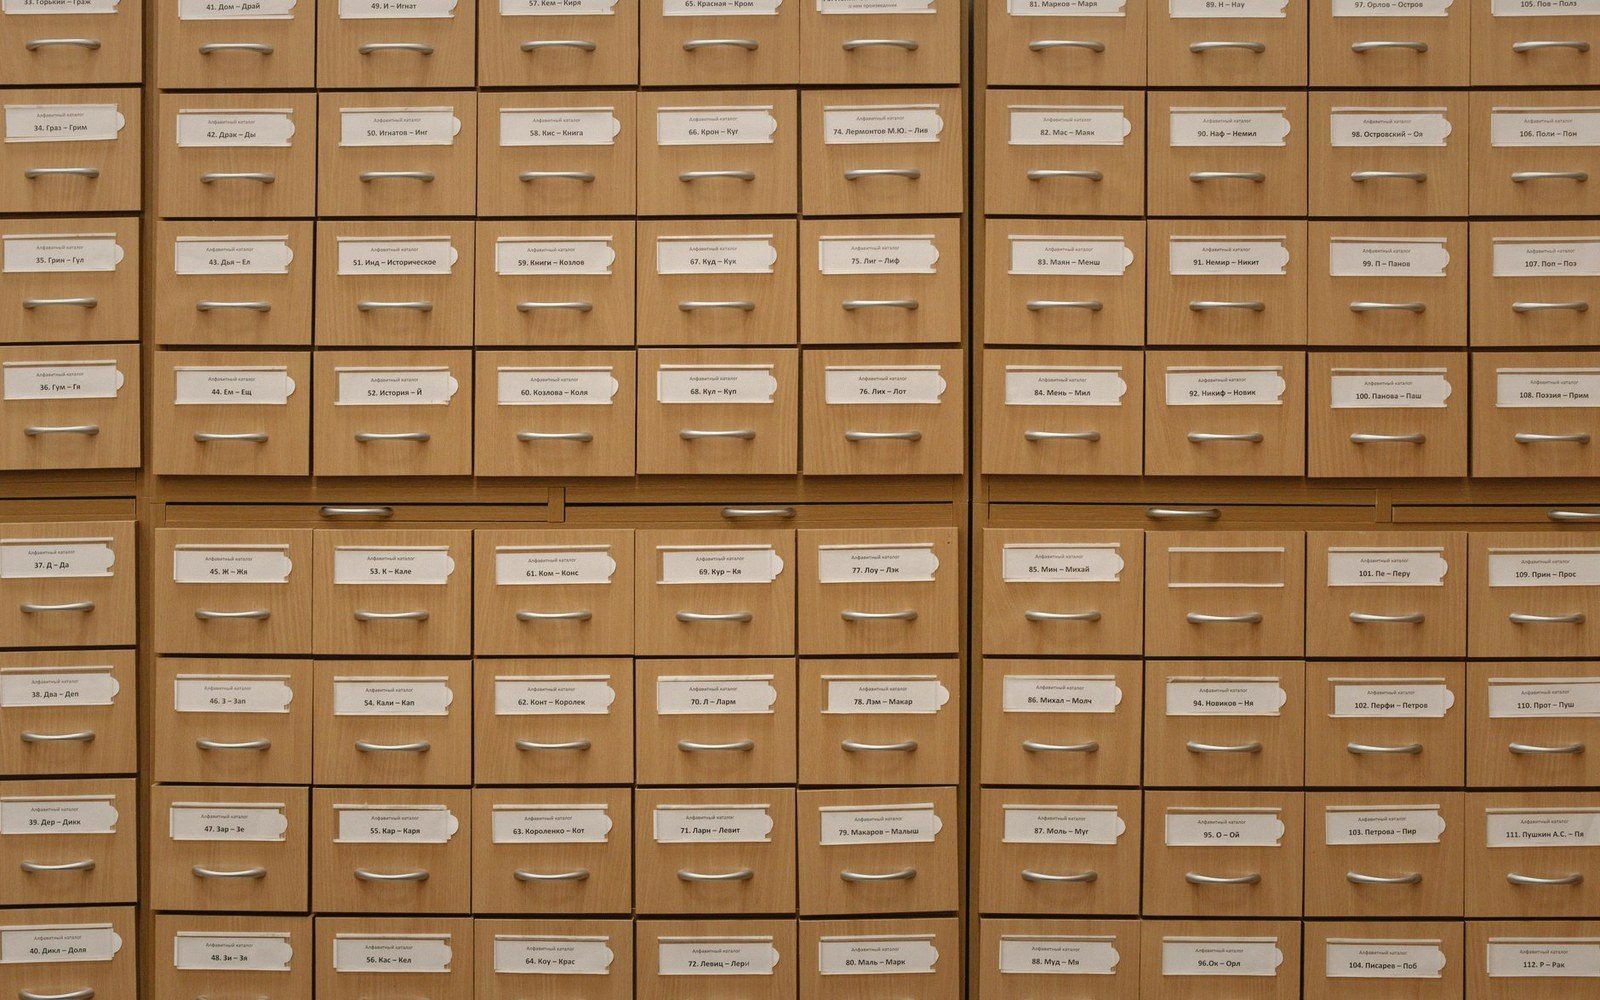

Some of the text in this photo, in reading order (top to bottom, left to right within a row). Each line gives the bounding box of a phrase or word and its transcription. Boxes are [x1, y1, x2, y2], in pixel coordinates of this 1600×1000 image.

[370, 2, 382, 10] 49.
[697, 0, 727, 8] Красная
[734, 0, 754, 8] Кром
[1029, 0, 1098, 8] 81. Марков Маря
[1366, 1, 1391, 10] Орлов
[1397, 1, 1424, 10] Остров
[218, 131, 238, 139] Драк
[243, 131, 256, 139] Ды
[530, 129, 541, 137] 58.
[845, 128, 886, 136] Лермонтов
[1209, 130, 1226, 138] Наф
[1519, 130, 1535, 138] 106.
[1536, 130, 1555, 138] Поли
[47, 256, 65, 265] Грин
[72, 256, 85, 265] Гул
[365, 259, 380, 267] Инд
[387, 259, 437, 267] Историческое
[689, 258, 737, 266] 67. Куд Кух
[1037, 258, 1049, 266] 83.
[223, 388, 234, 396] Ем
[241, 388, 252, 396] Ещ
[1201, 389, 1226, 398] Никиф
[1519, 391, 1589, 400] 108. Поэзия Прим
[59, 561, 70, 569] Да
[369, 567, 381, 575] 53.
[711, 568, 725, 576] Кур
[1392, 570, 1411, 578] Перу
[209, 697, 220, 705] 46.
[233, 697, 246, 705] Зап
[517, 698, 529, 706] 62.
[554, 699, 586, 707] Королек
[854, 698, 913, 706] 78. Лэм Макар
[1533, 701, 1552, 710] Прот
[1558, 701, 1575, 709] Пуш
[29, 818, 81, 827] 39. Дер Дикк
[370, 827, 421, 835] 55. Кар Каря
[692, 827, 711, 835] Ларн
[1034, 827, 1089, 836] 87. Моль Муг
[1364, 828, 1395, 836] Петрова
[1402, 828, 1417, 836] Пир
[1522, 831, 1552, 839] Пушкин
[1552, 830, 1567, 838] А.С.
[223, 954, 233, 962] Зи
[239, 954, 248, 962] Зя
[525, 957, 575, 966] 64. Коу Крас
[885, 958, 906, 966] Марк
[1225, 960, 1241, 968] Орл
